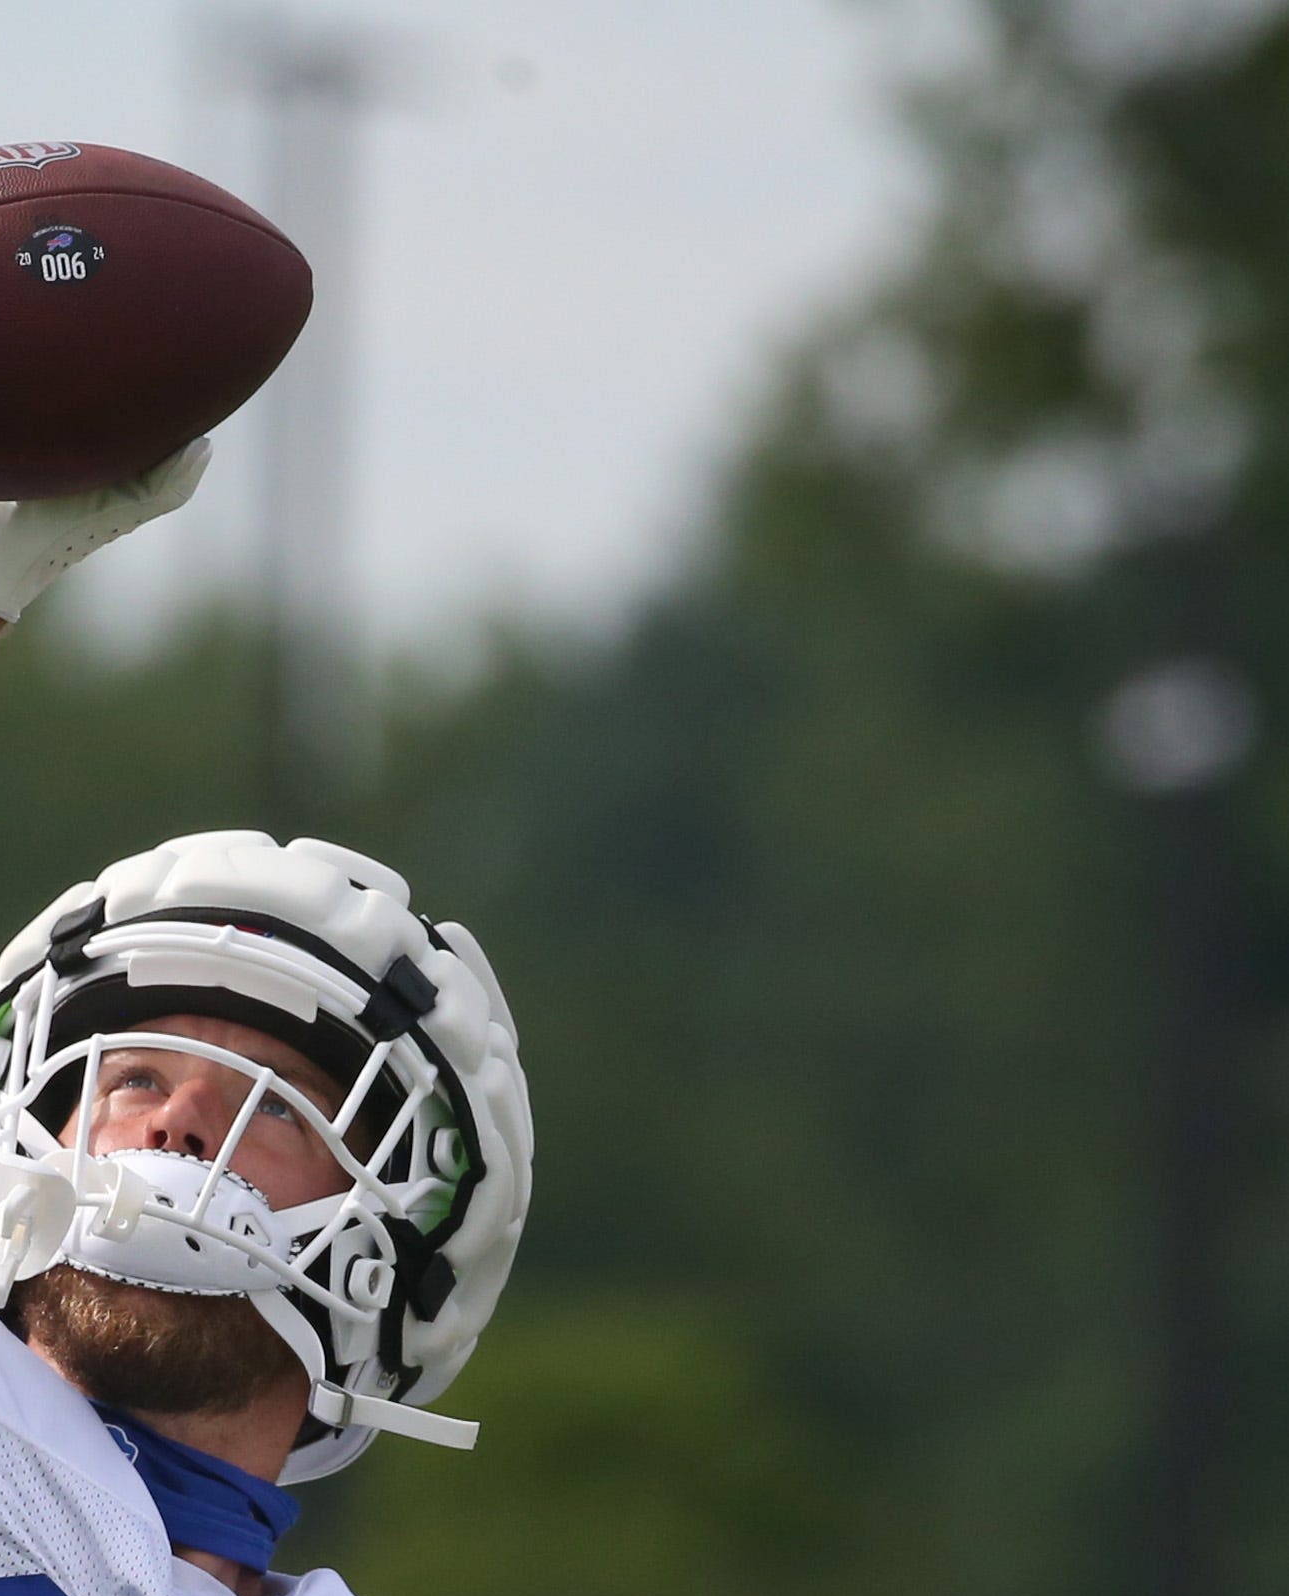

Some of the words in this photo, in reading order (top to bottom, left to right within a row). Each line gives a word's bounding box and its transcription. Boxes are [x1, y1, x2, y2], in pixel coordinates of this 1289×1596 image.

[17, 252, 32, 266] 20
[41, 252, 86, 281] 006
[92, 246, 105, 260] 24
